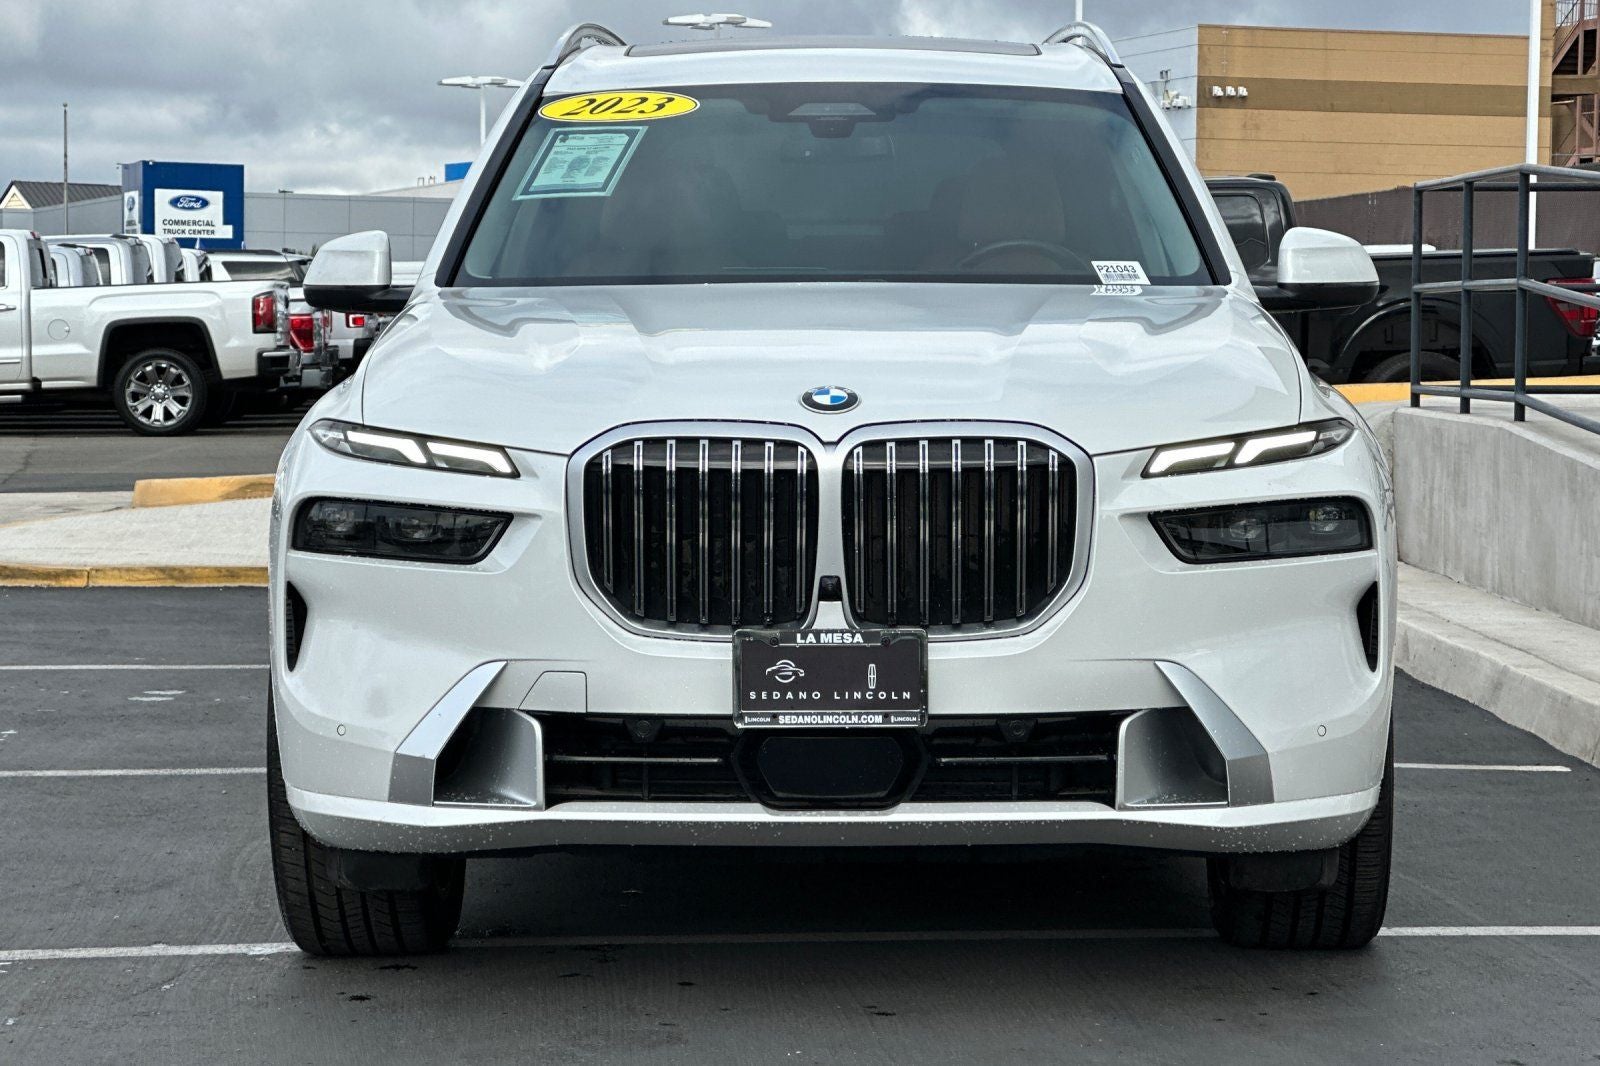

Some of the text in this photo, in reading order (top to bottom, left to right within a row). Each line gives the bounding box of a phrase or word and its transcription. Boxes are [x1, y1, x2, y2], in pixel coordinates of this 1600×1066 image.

[559, 96, 675, 116] 2023
[177, 197, 202, 208] Ford
[162, 219, 215, 227] COMMERCIAL
[1096, 265, 1137, 273] P21043
[796, 633, 864, 644] LA MESA
[750, 691, 911, 700] SEDANO LINCOLN
[778, 715, 883, 724] SEDANOLINCOLN.COM
